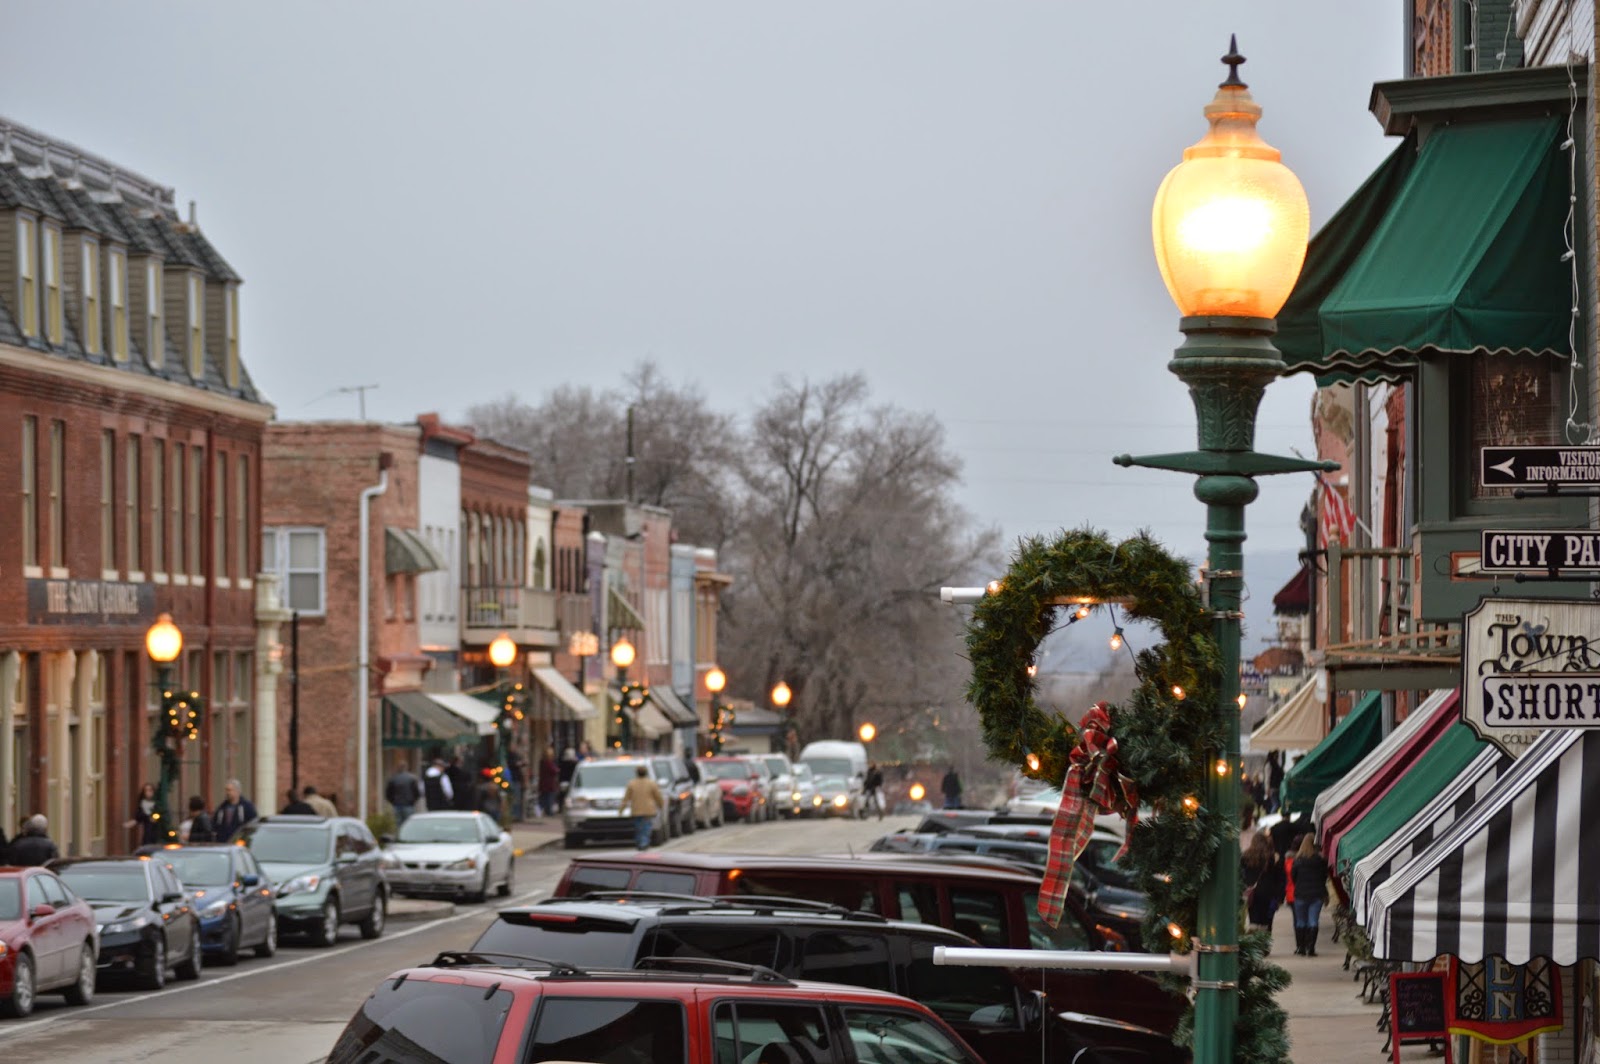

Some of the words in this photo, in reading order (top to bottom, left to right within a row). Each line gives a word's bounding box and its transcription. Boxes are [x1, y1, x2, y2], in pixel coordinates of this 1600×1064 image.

[1490, 534, 1552, 566] CITY
[1564, 535, 1600, 566] PA
[1495, 613, 1515, 622] THE
[1487, 615, 1590, 666] Town
